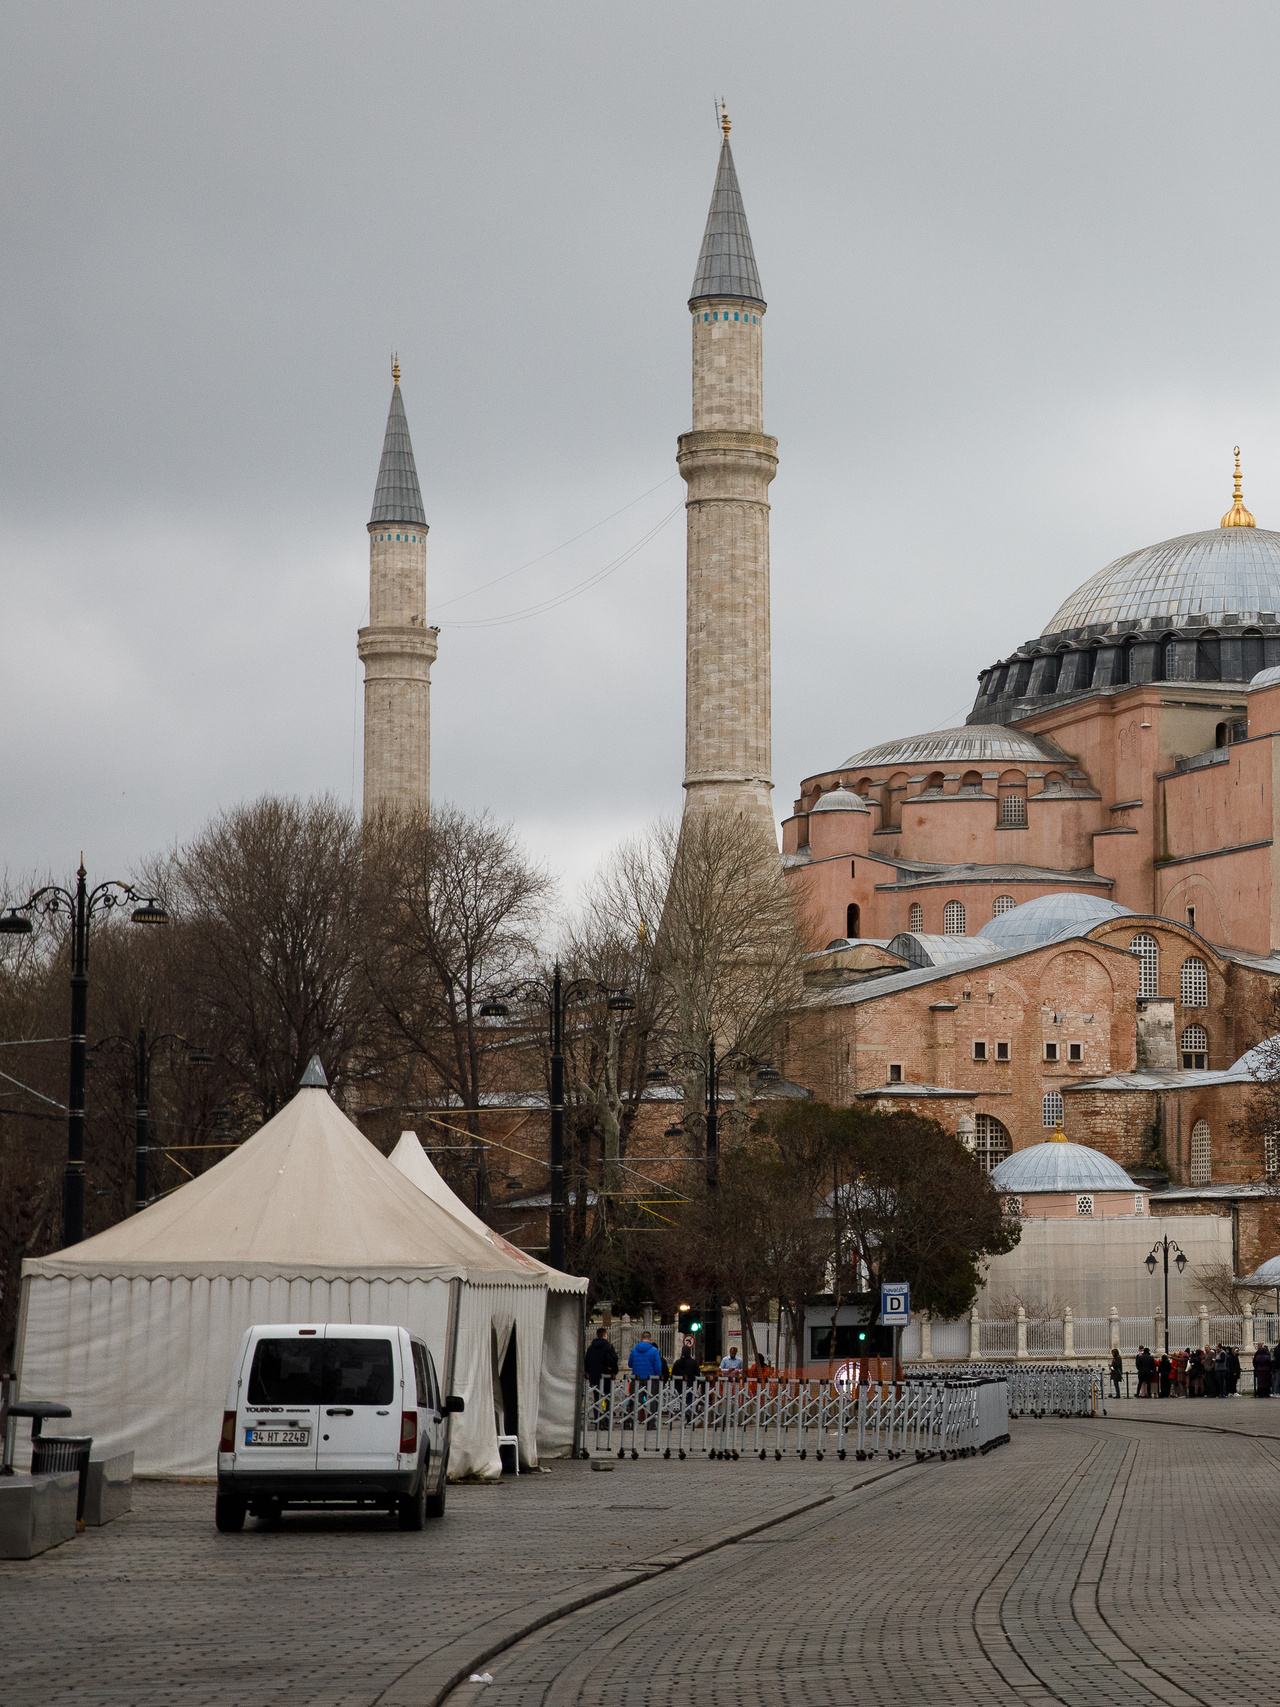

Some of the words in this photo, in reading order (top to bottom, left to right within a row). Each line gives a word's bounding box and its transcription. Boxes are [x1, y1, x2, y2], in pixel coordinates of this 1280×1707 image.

[890, 1297, 901, 1310] D
[252, 1432, 264, 1442] 34
[267, 1431, 279, 1442] HT
[282, 1431, 306, 1442] 2248
